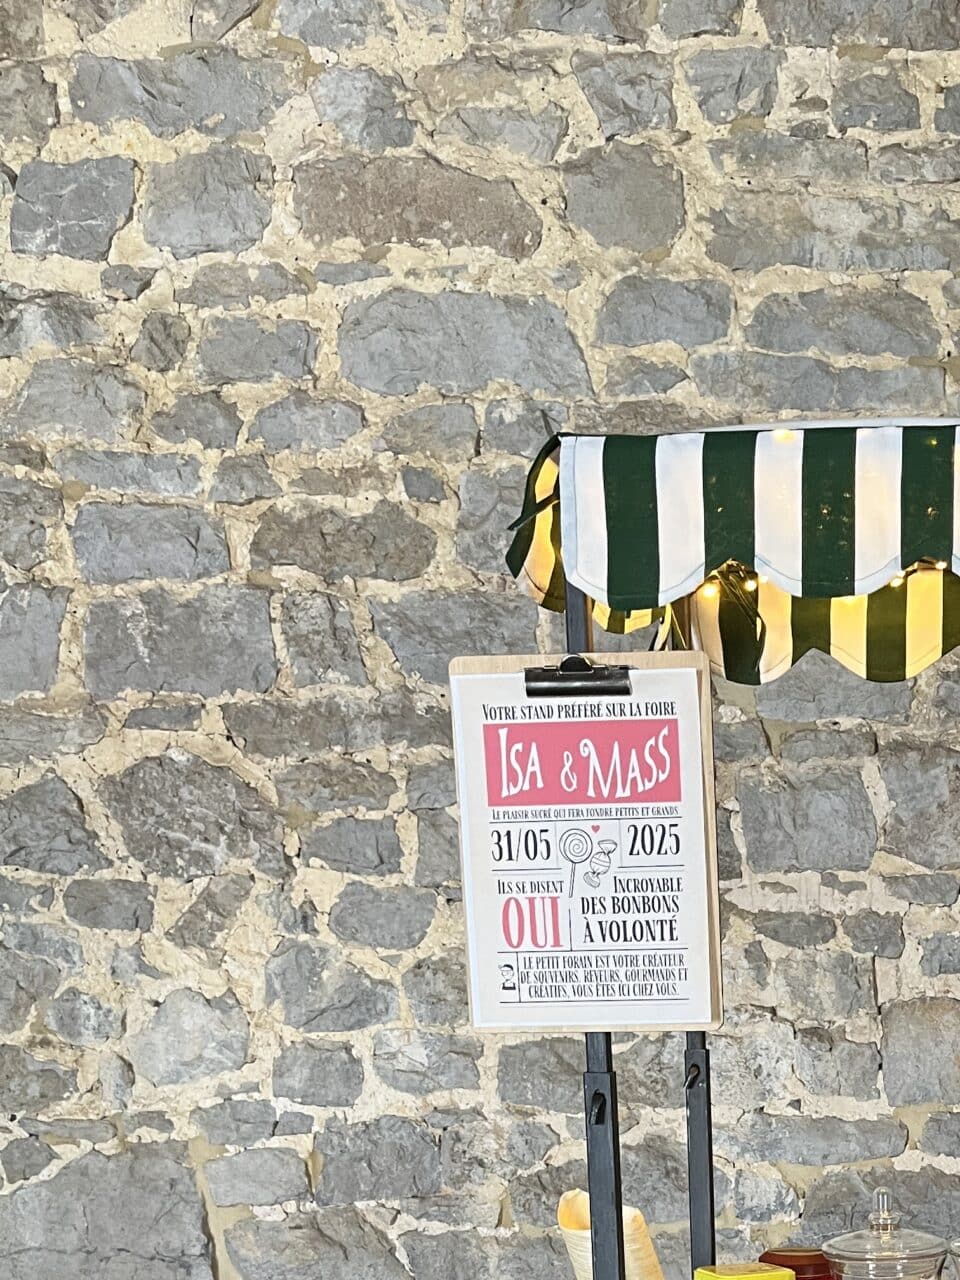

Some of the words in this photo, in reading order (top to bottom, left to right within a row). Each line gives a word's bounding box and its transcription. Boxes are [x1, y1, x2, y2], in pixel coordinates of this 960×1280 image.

[520, 704, 554, 720] STAND
[557, 702, 602, 719] PRÉFÉRÉ
[605, 703, 627, 718] SUR
[629, 703, 643, 717] LA
[645, 702, 677, 716] FOIRE
[560, 751, 577, 792] &
[502, 808, 529, 820] PLAISIR
[553, 808, 567, 819] QUI
[615, 806, 640, 817] PETITS
[641, 806, 651, 816] ET
[652, 805, 679, 816] GRANDS
[491, 828, 551, 862] 31/05
[627, 823, 680, 856] 2025
[516, 880, 528, 894] SE
[530, 879, 564, 894] DISENT
[613, 876, 683, 894] INCROYABLE
[581, 896, 607, 915] DES
[612, 894, 680, 914] BONBONS
[502, 897, 564, 949] OUI
[584, 917, 595, 943] À
[598, 915, 679, 943] VOLONTÉ
[523, 956, 534, 970] LE
[535, 956, 560, 970] PETIT
[562, 955, 593, 969] FORAIN
[595, 954, 610, 969] EST
[612, 953, 641, 968] VOTRE
[642, 951, 685, 967] CRÉATEUR
[520, 970, 531, 984] DE
[625, 968, 676, 982] GOURMANDS
[678, 967, 688, 981] ET
[572, 984, 594, 997] VOUS
[618, 983, 630, 996] ICI
[632, 983, 654, 996] CHEZ
